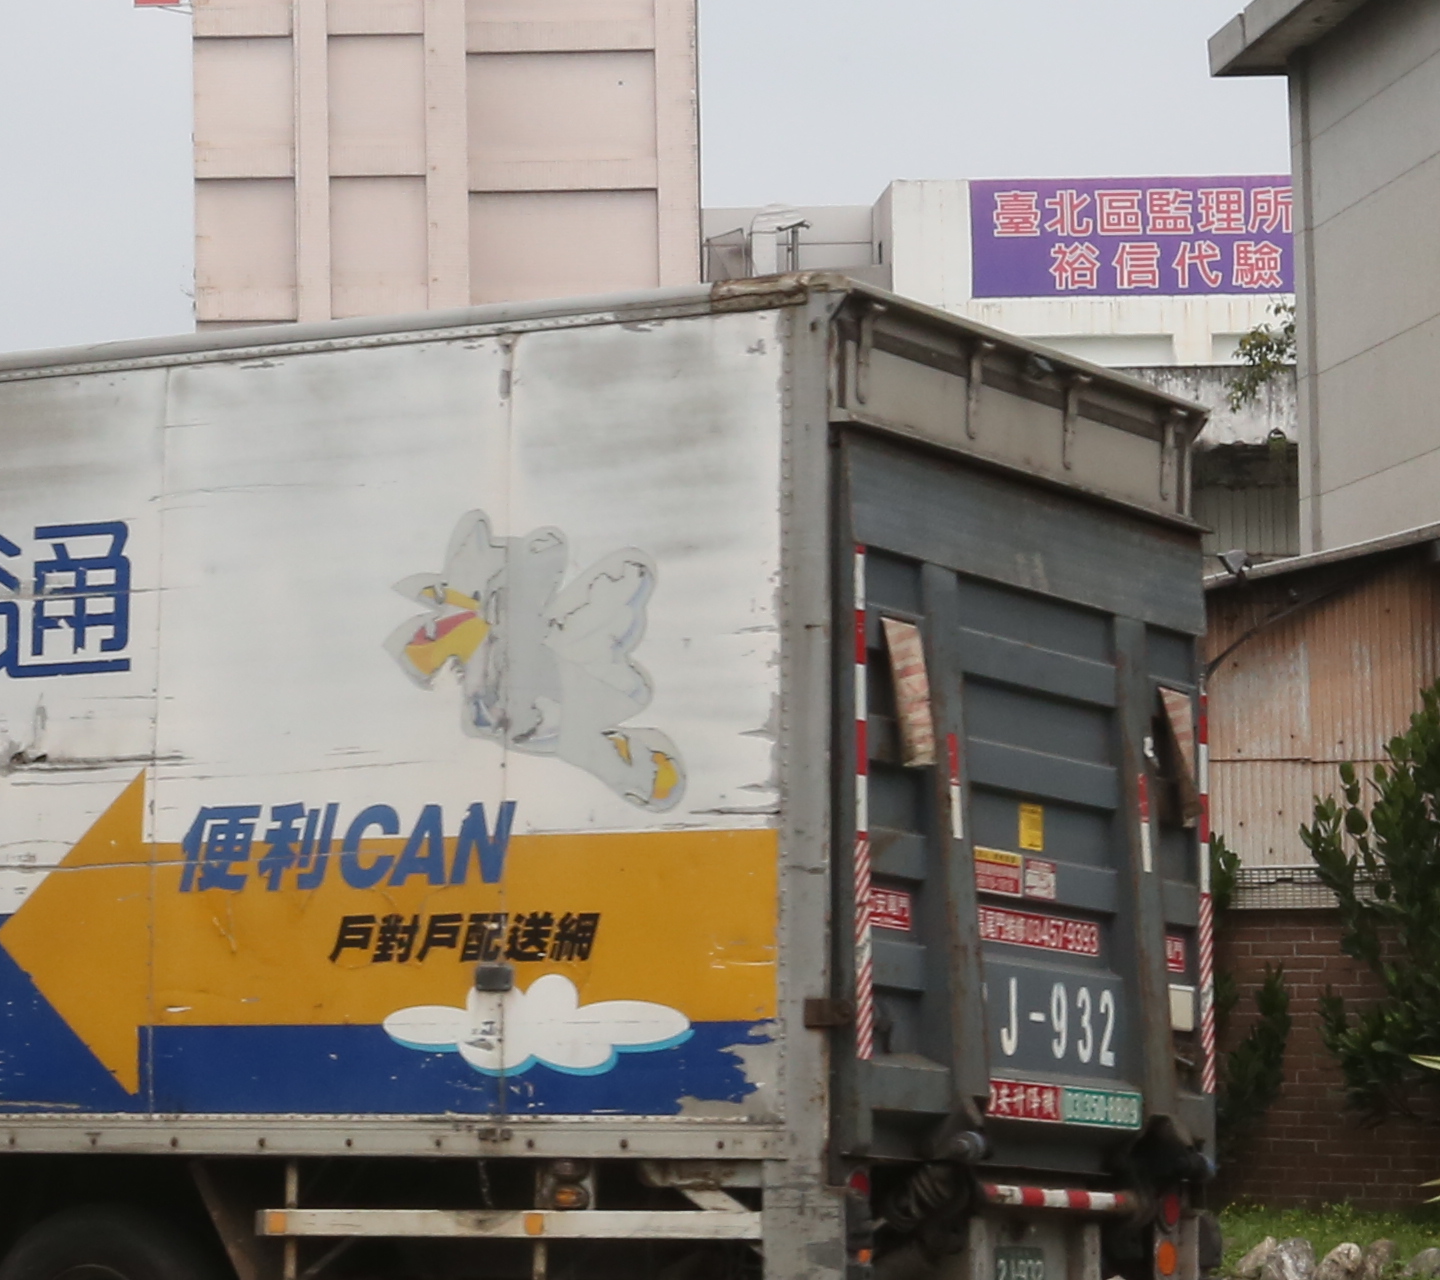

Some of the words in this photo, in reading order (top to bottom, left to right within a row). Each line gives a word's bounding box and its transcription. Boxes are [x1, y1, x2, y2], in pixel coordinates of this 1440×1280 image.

[993, 185, 1292, 237] 臺北區監理所
[1050, 241, 1283, 291] 裕信代驗
[179, 800, 517, 892] 便利CAN
[329, 912, 601, 964] 戶對戶配送網
